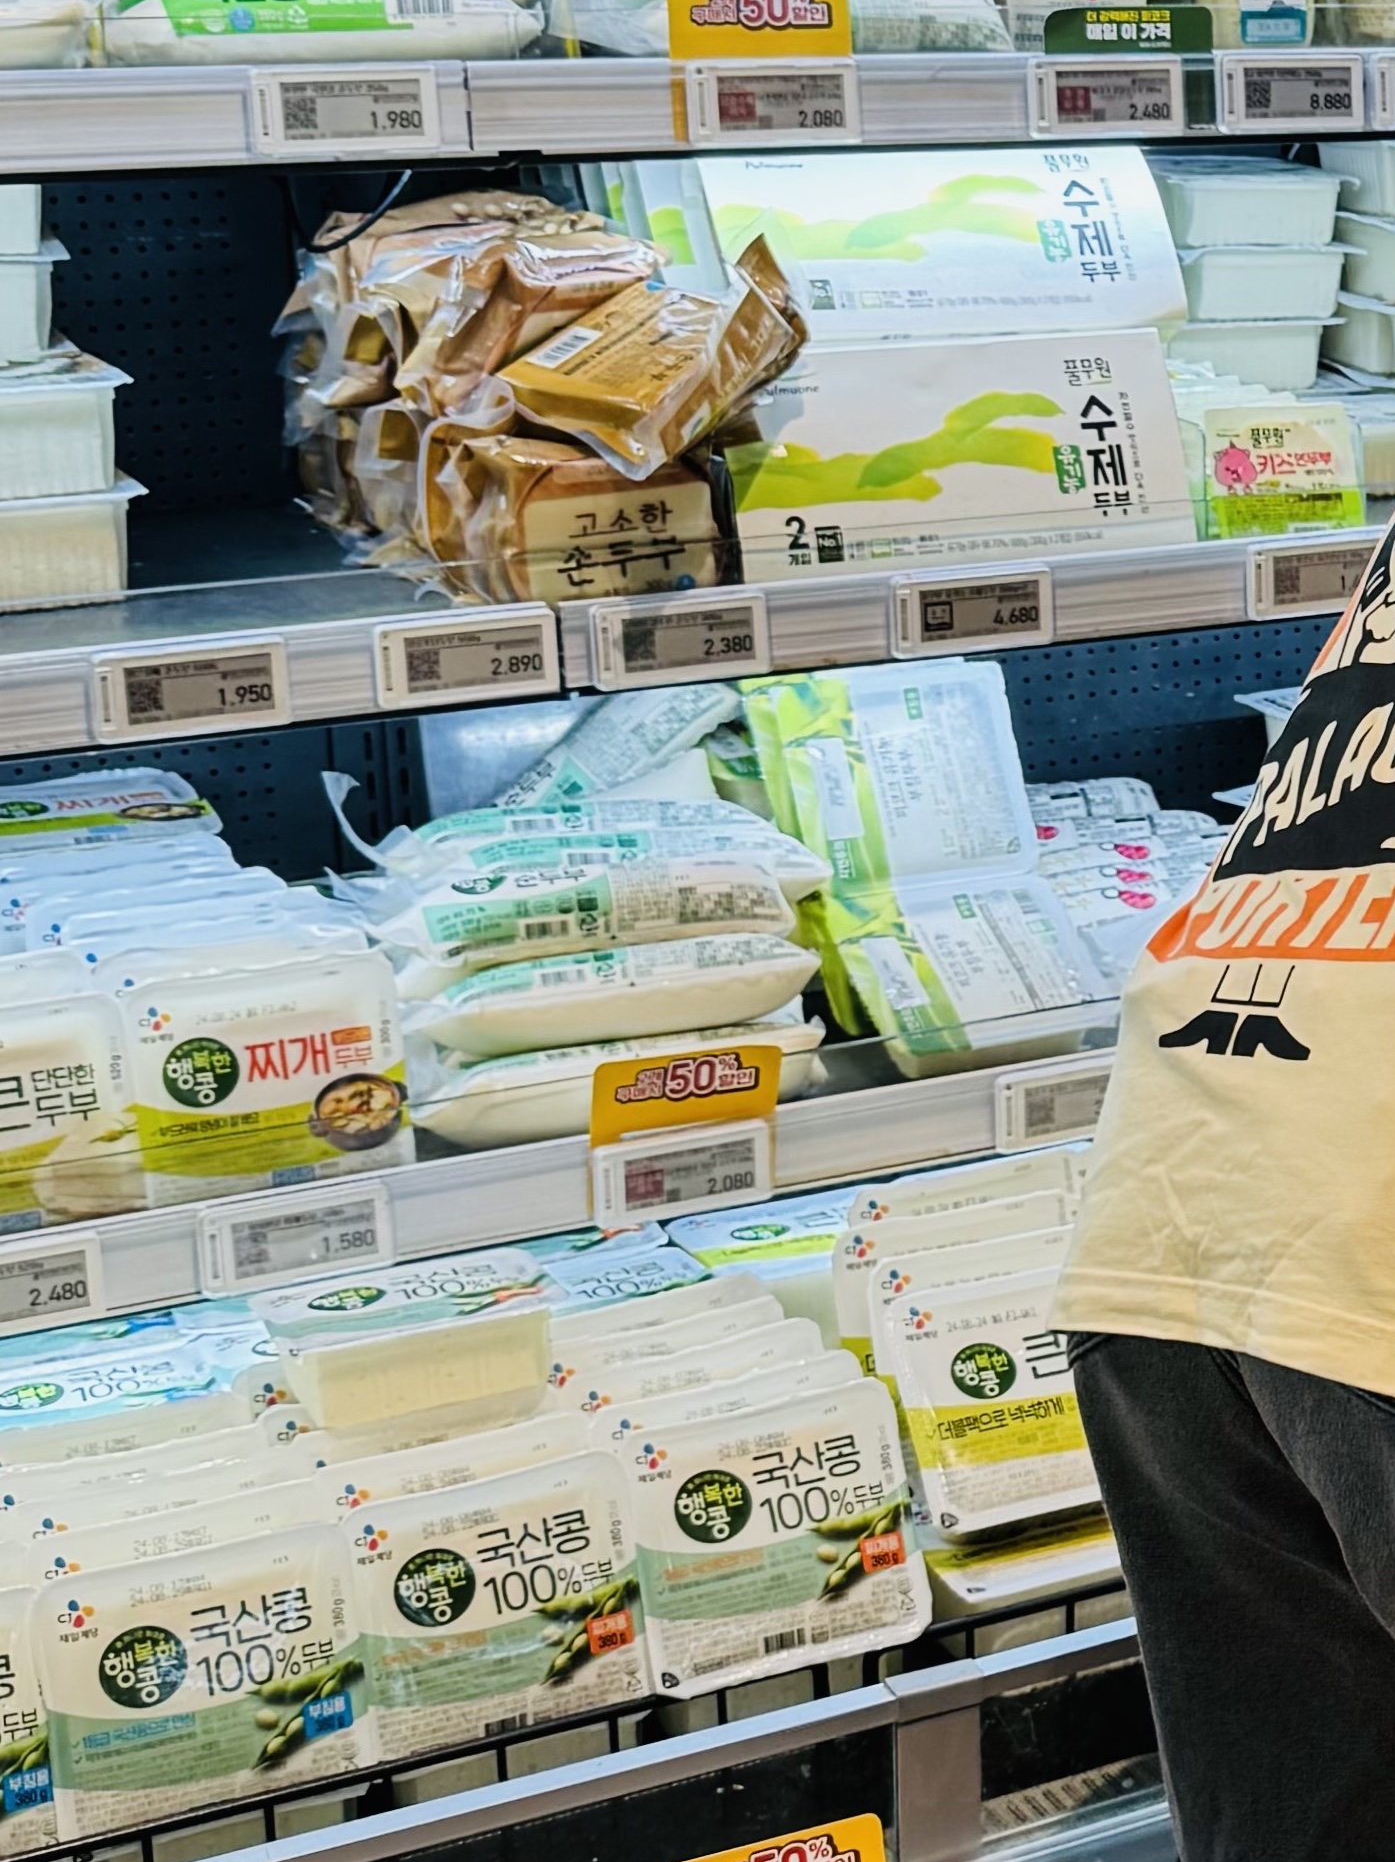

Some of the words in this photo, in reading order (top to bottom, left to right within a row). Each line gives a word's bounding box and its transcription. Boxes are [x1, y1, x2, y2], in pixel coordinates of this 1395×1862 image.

[1086, 23, 1119, 41] 매일
[1140, 22, 1171, 41] 가격
[1063, 356, 1114, 387] 풀무원
[1257, 453, 1293, 476] 키즈
[568, 500, 674, 537] 고소한
[1093, 490, 1133, 517] 두부
[785, 516, 810, 550] 2
[557, 536, 686, 587] 손두부
[31, 1063, 96, 1093] 단단한
[244, 1032, 330, 1084] 찌개
[334, 1046, 374, 1067] 두부
[664, 1053, 737, 1098] 50%
[35, 1088, 101, 1127] 두부
[752, 1434, 861, 1491] 국산콩
[758, 1485, 855, 1534] 100%
[477, 1509, 592, 1566] 국산콩
[482, 1564, 582, 1616] 100%
[189, 1586, 313, 1647] 국산콩
[196, 1645, 300, 1697] 100%
[300, 1640, 335, 1674] 두부
